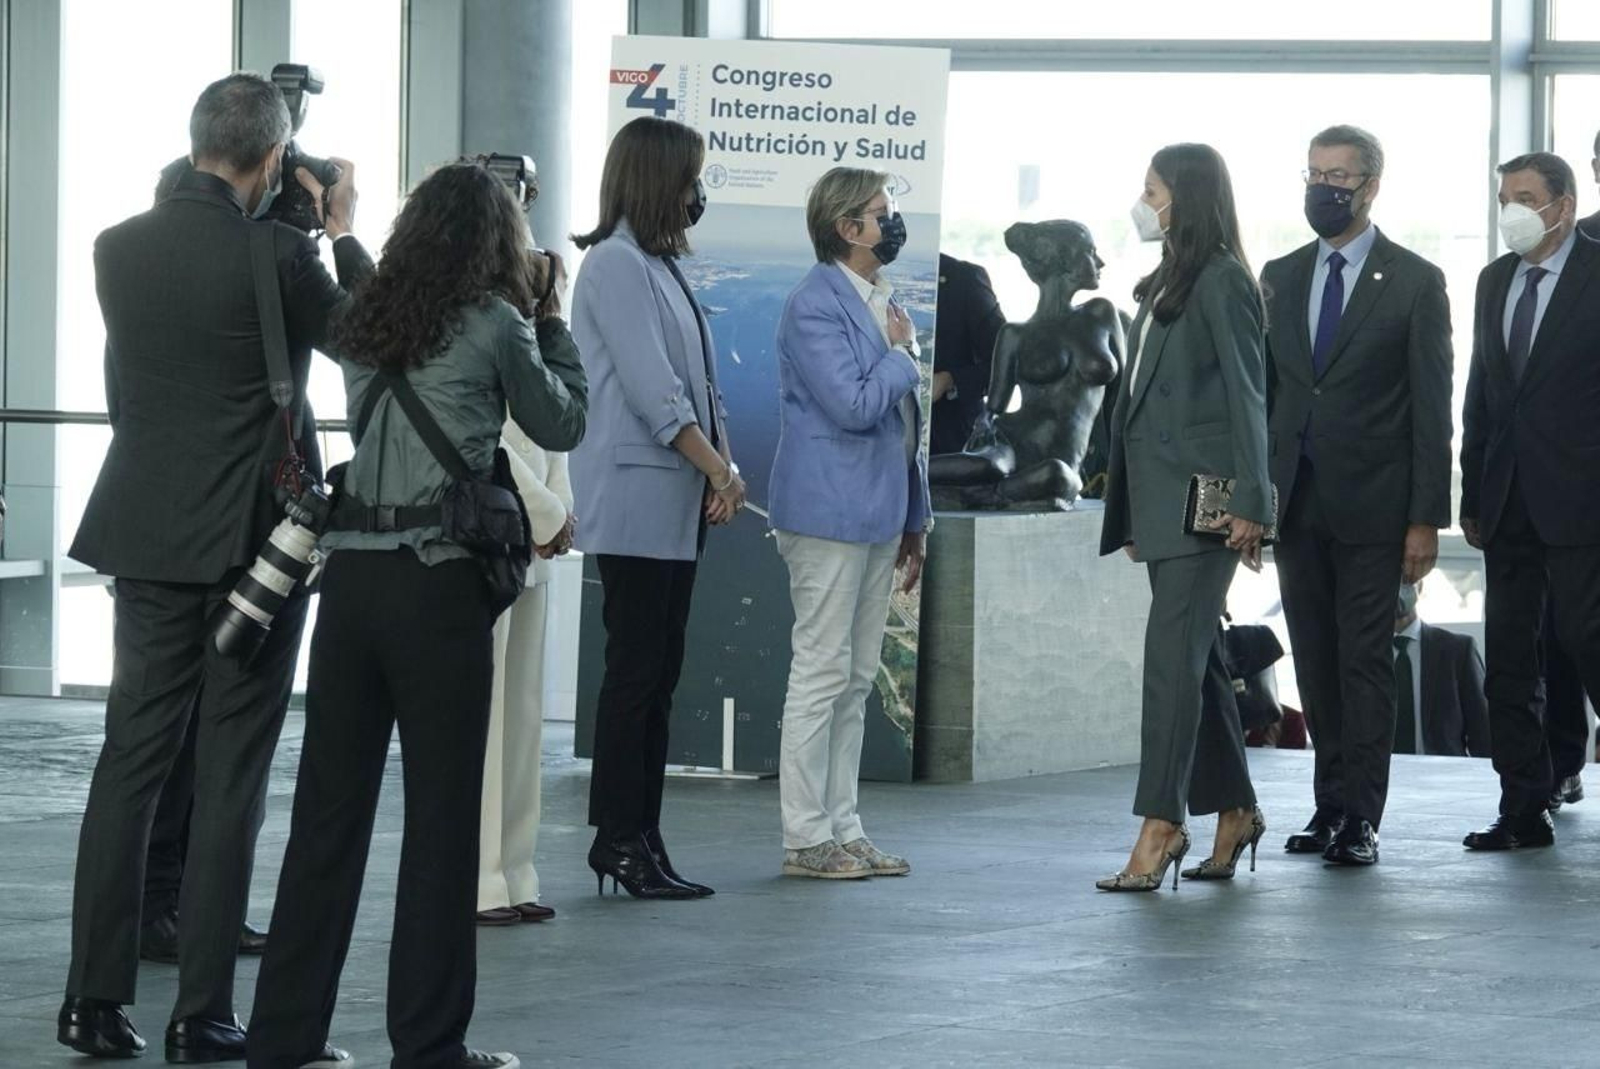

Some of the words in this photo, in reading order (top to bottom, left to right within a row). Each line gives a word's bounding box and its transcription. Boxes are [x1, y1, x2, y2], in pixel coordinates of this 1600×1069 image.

[615, 71, 648, 84] VIGO
[626, 63, 676, 118] 4
[711, 63, 833, 92] Congreso
[710, 97, 877, 125] Internacional
[884, 104, 917, 127] de
[708, 130, 826, 156] Nutrición
[832, 140, 849, 163] y
[855, 137, 926, 161] Salud
